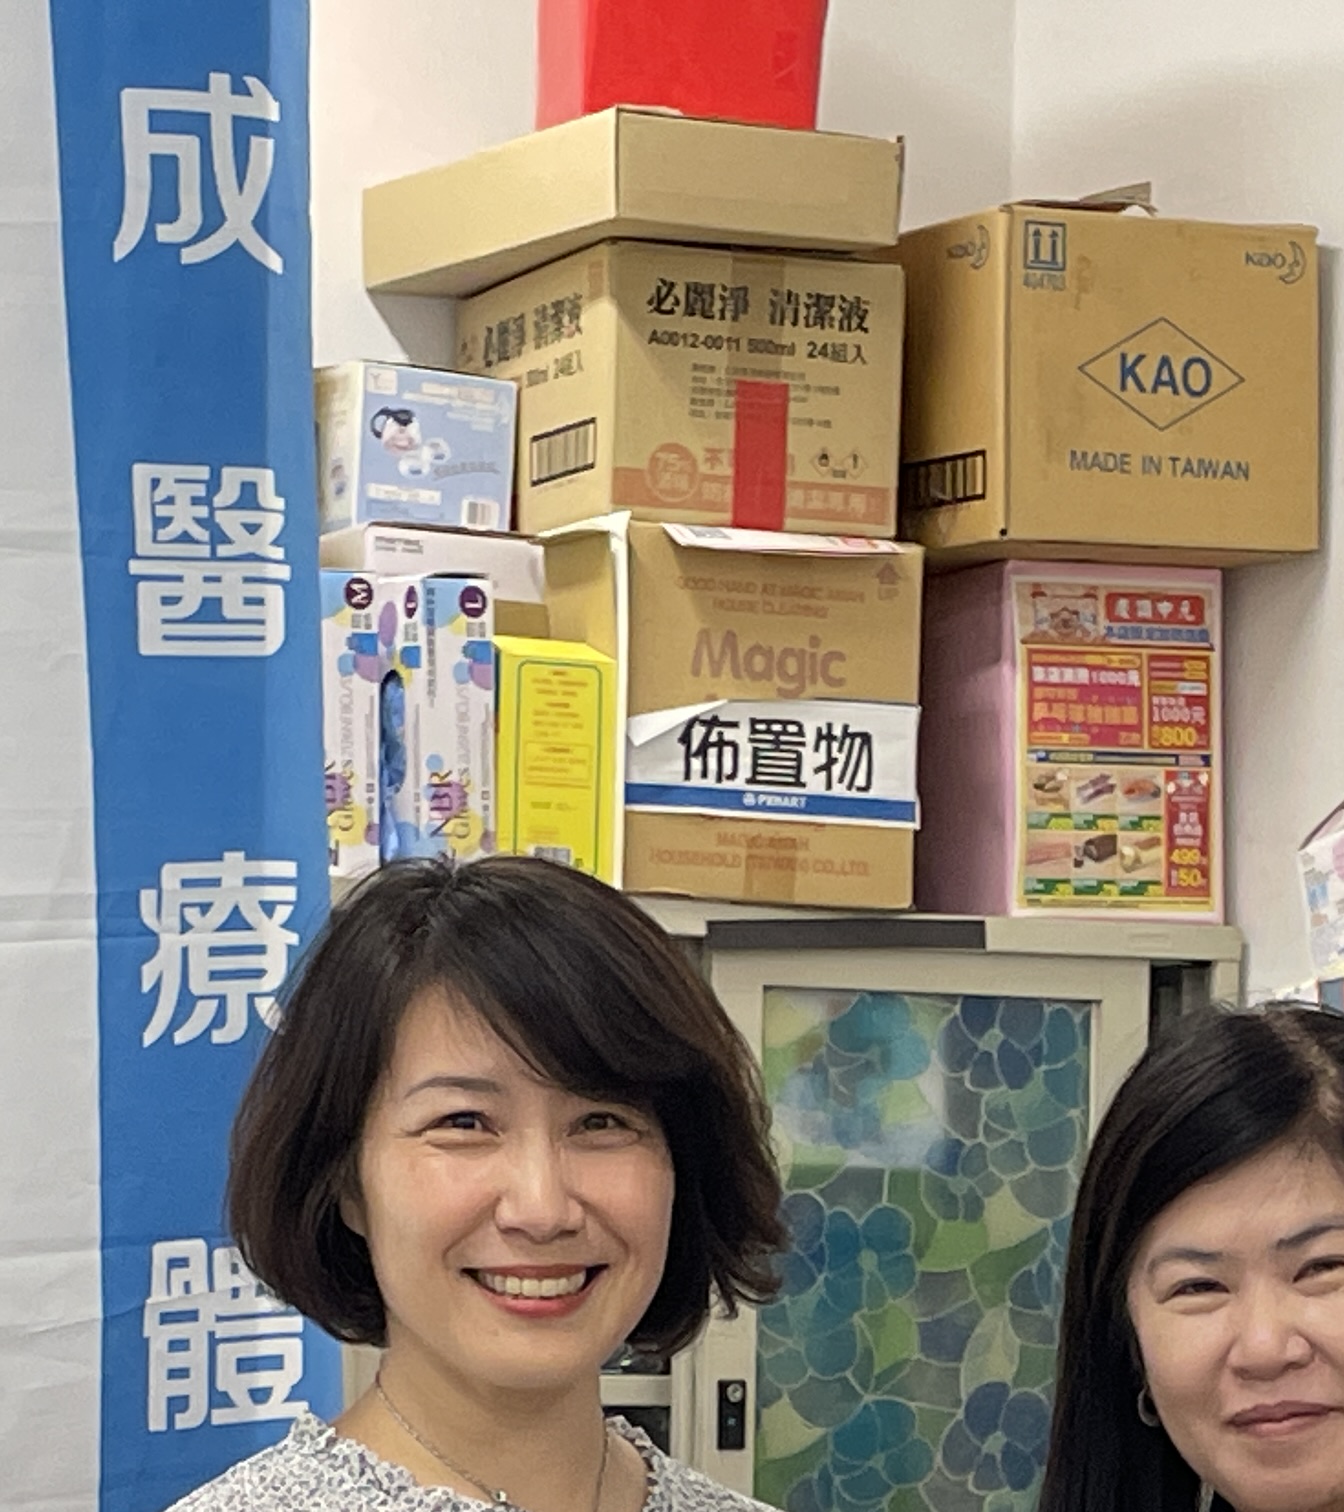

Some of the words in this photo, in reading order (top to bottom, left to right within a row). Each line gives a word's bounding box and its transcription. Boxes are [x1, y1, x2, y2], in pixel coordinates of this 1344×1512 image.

[646, 277, 750, 323] 必麗淨
[767, 287, 871, 335] 清潔液
[1119, 352, 1213, 398] KAO
[1069, 450, 1132, 475] MADE
[1141, 455, 1163, 477] IN
[1167, 456, 1251, 482] TAIWAN
[690, 627, 848, 699] Magic
[677, 714, 874, 792] 佈置物
